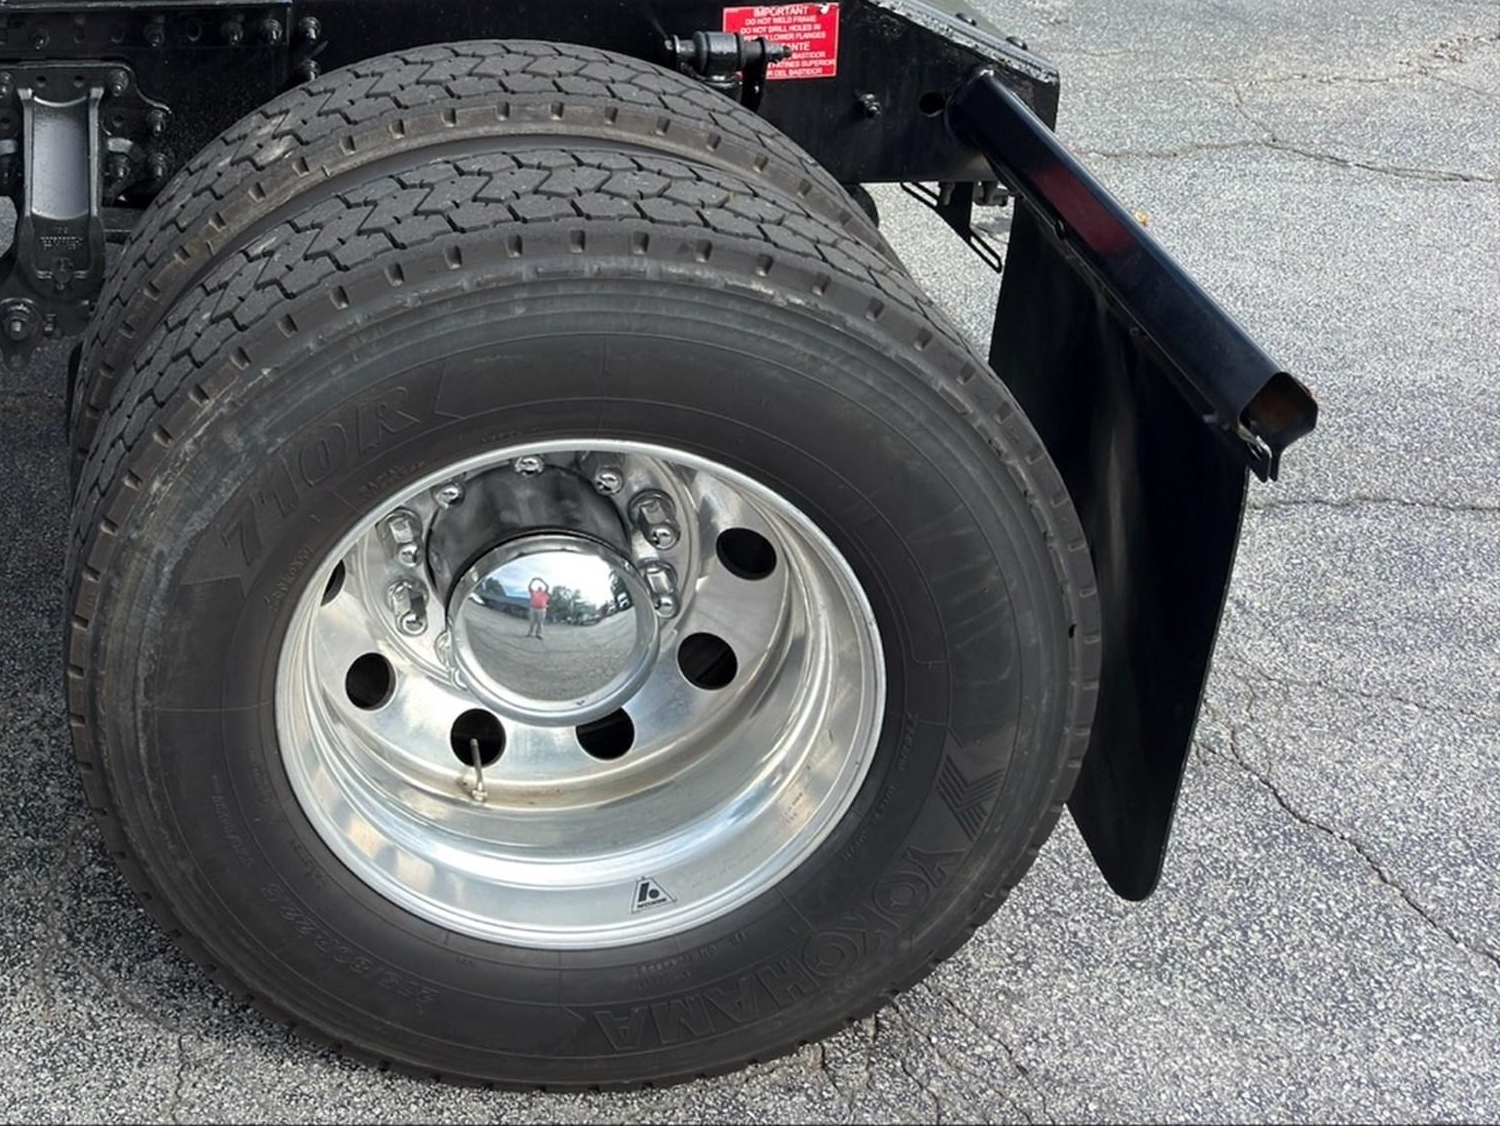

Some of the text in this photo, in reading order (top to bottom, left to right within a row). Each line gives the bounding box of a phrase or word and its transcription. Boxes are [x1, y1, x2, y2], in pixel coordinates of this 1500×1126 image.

[753, 6, 809, 17] IMPORTANT
[745, 18, 756, 26] DO
[757, 17, 772, 25] NOT
[772, 16, 792, 24] WELD
[740, 26, 752, 35] DO
[753, 25, 767, 34] NOT
[788, 24, 812, 32] HOLES
[594, 845, 966, 1053] YOKOHAMA
